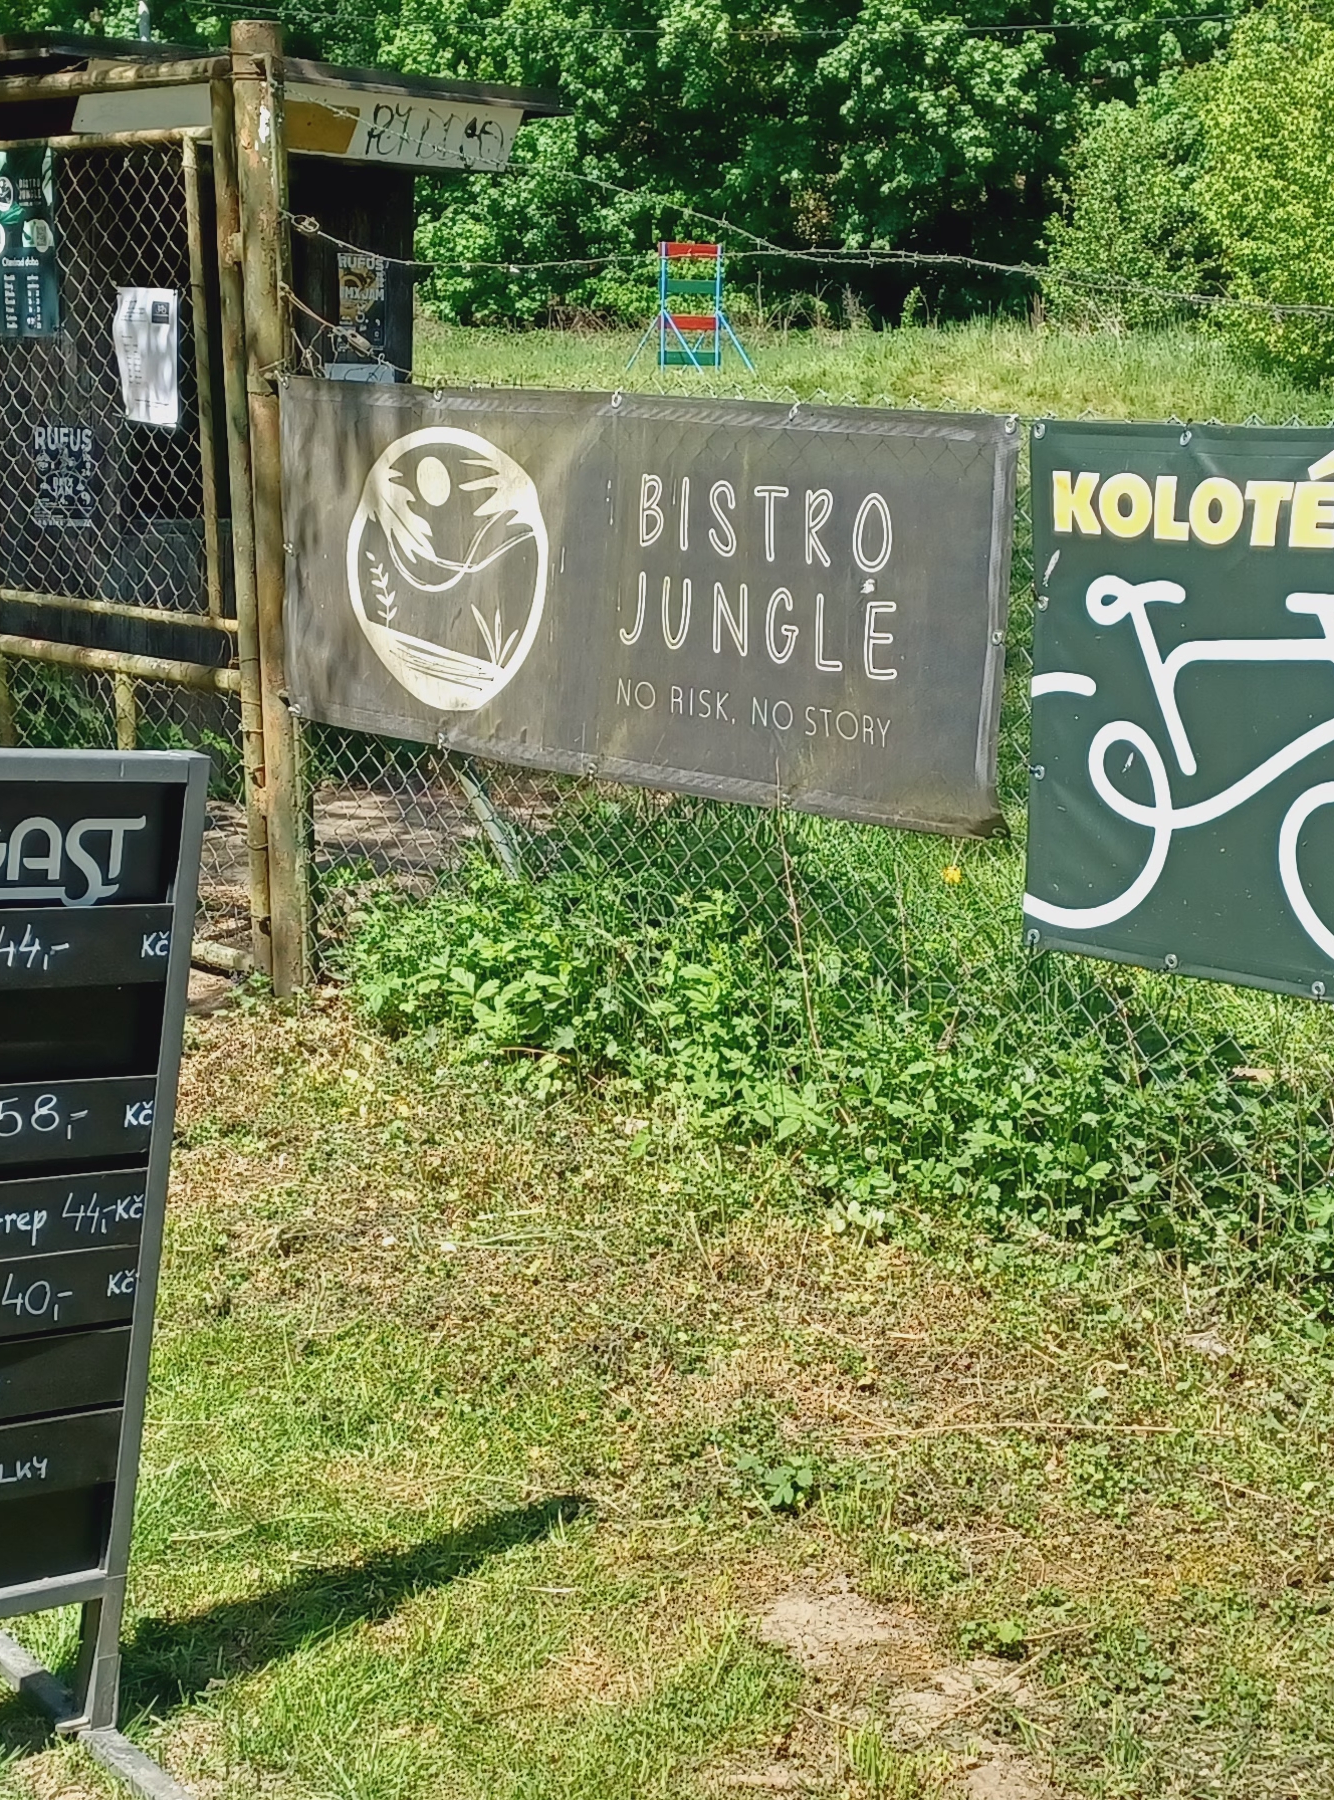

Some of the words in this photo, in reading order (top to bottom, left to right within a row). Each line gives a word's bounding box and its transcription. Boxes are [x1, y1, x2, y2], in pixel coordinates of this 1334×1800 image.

[34, 426, 93, 452] RUFUS
[638, 473, 893, 573] BISTRO
[619, 571, 898, 681] JUNGLE
[616, 677, 656, 710] NO
[670, 685, 736, 725] RISK,
[751, 696, 794, 731] NO
[804, 706, 892, 748] STORY
[140, 931, 170, 959] Kč
[124, 1100, 154, 1127] Kč
[115, 1193, 144, 1222] Kč
[107, 1269, 136, 1297] Kč
